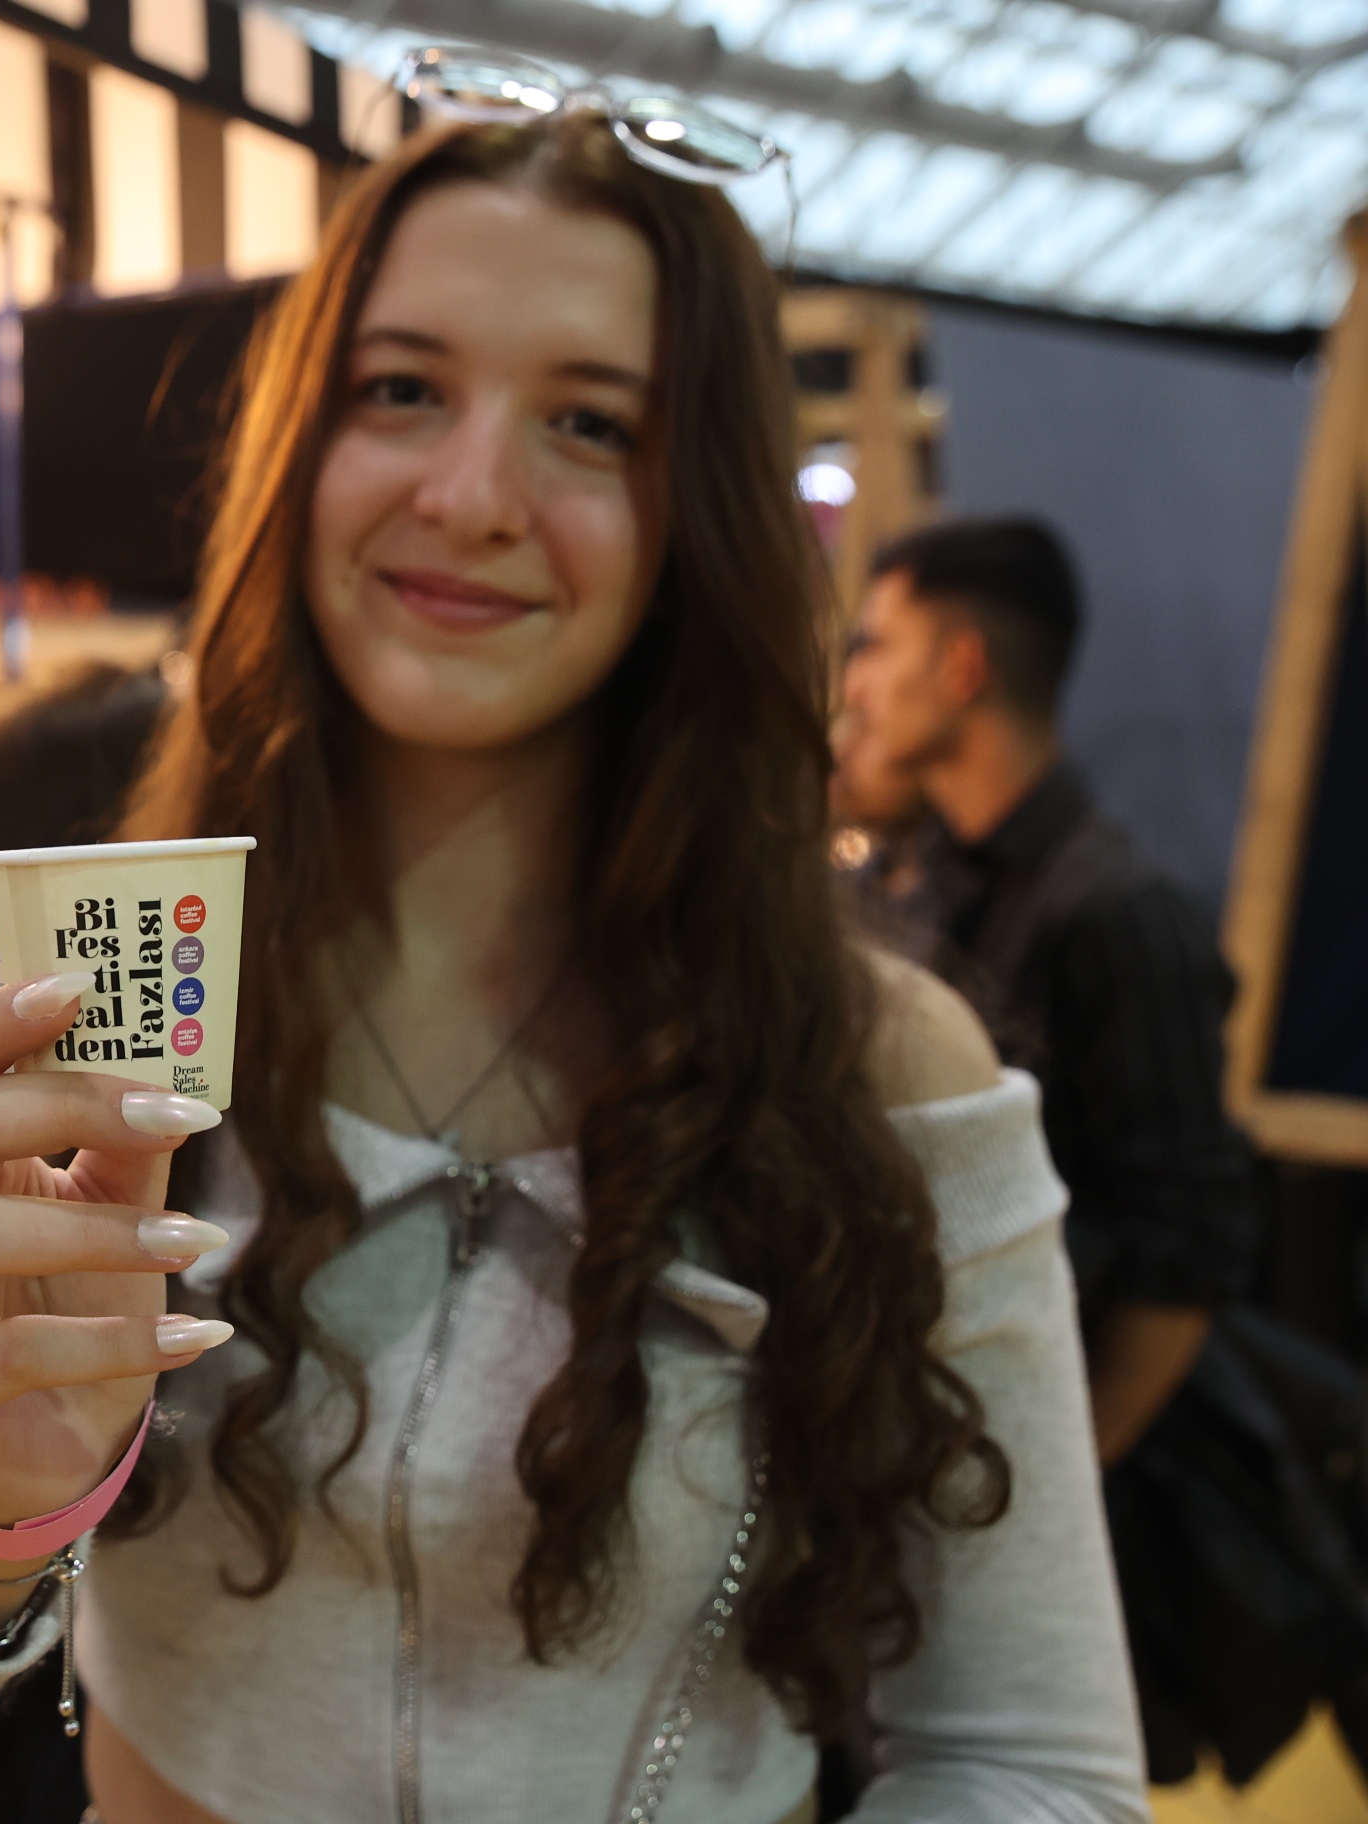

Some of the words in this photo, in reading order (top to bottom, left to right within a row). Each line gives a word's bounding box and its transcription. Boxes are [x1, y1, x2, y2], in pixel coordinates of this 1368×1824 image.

[74, 897, 119, 931] Bi
[54, 927, 121, 959] Fes
[92, 960, 124, 994] ti
[129, 897, 164, 1062] Fazlası
[54, 1030, 129, 1062] den
[173, 1065, 204, 1076] Dream
[173, 1073, 196, 1085] Sales
[173, 1079, 210, 1095] Machine
